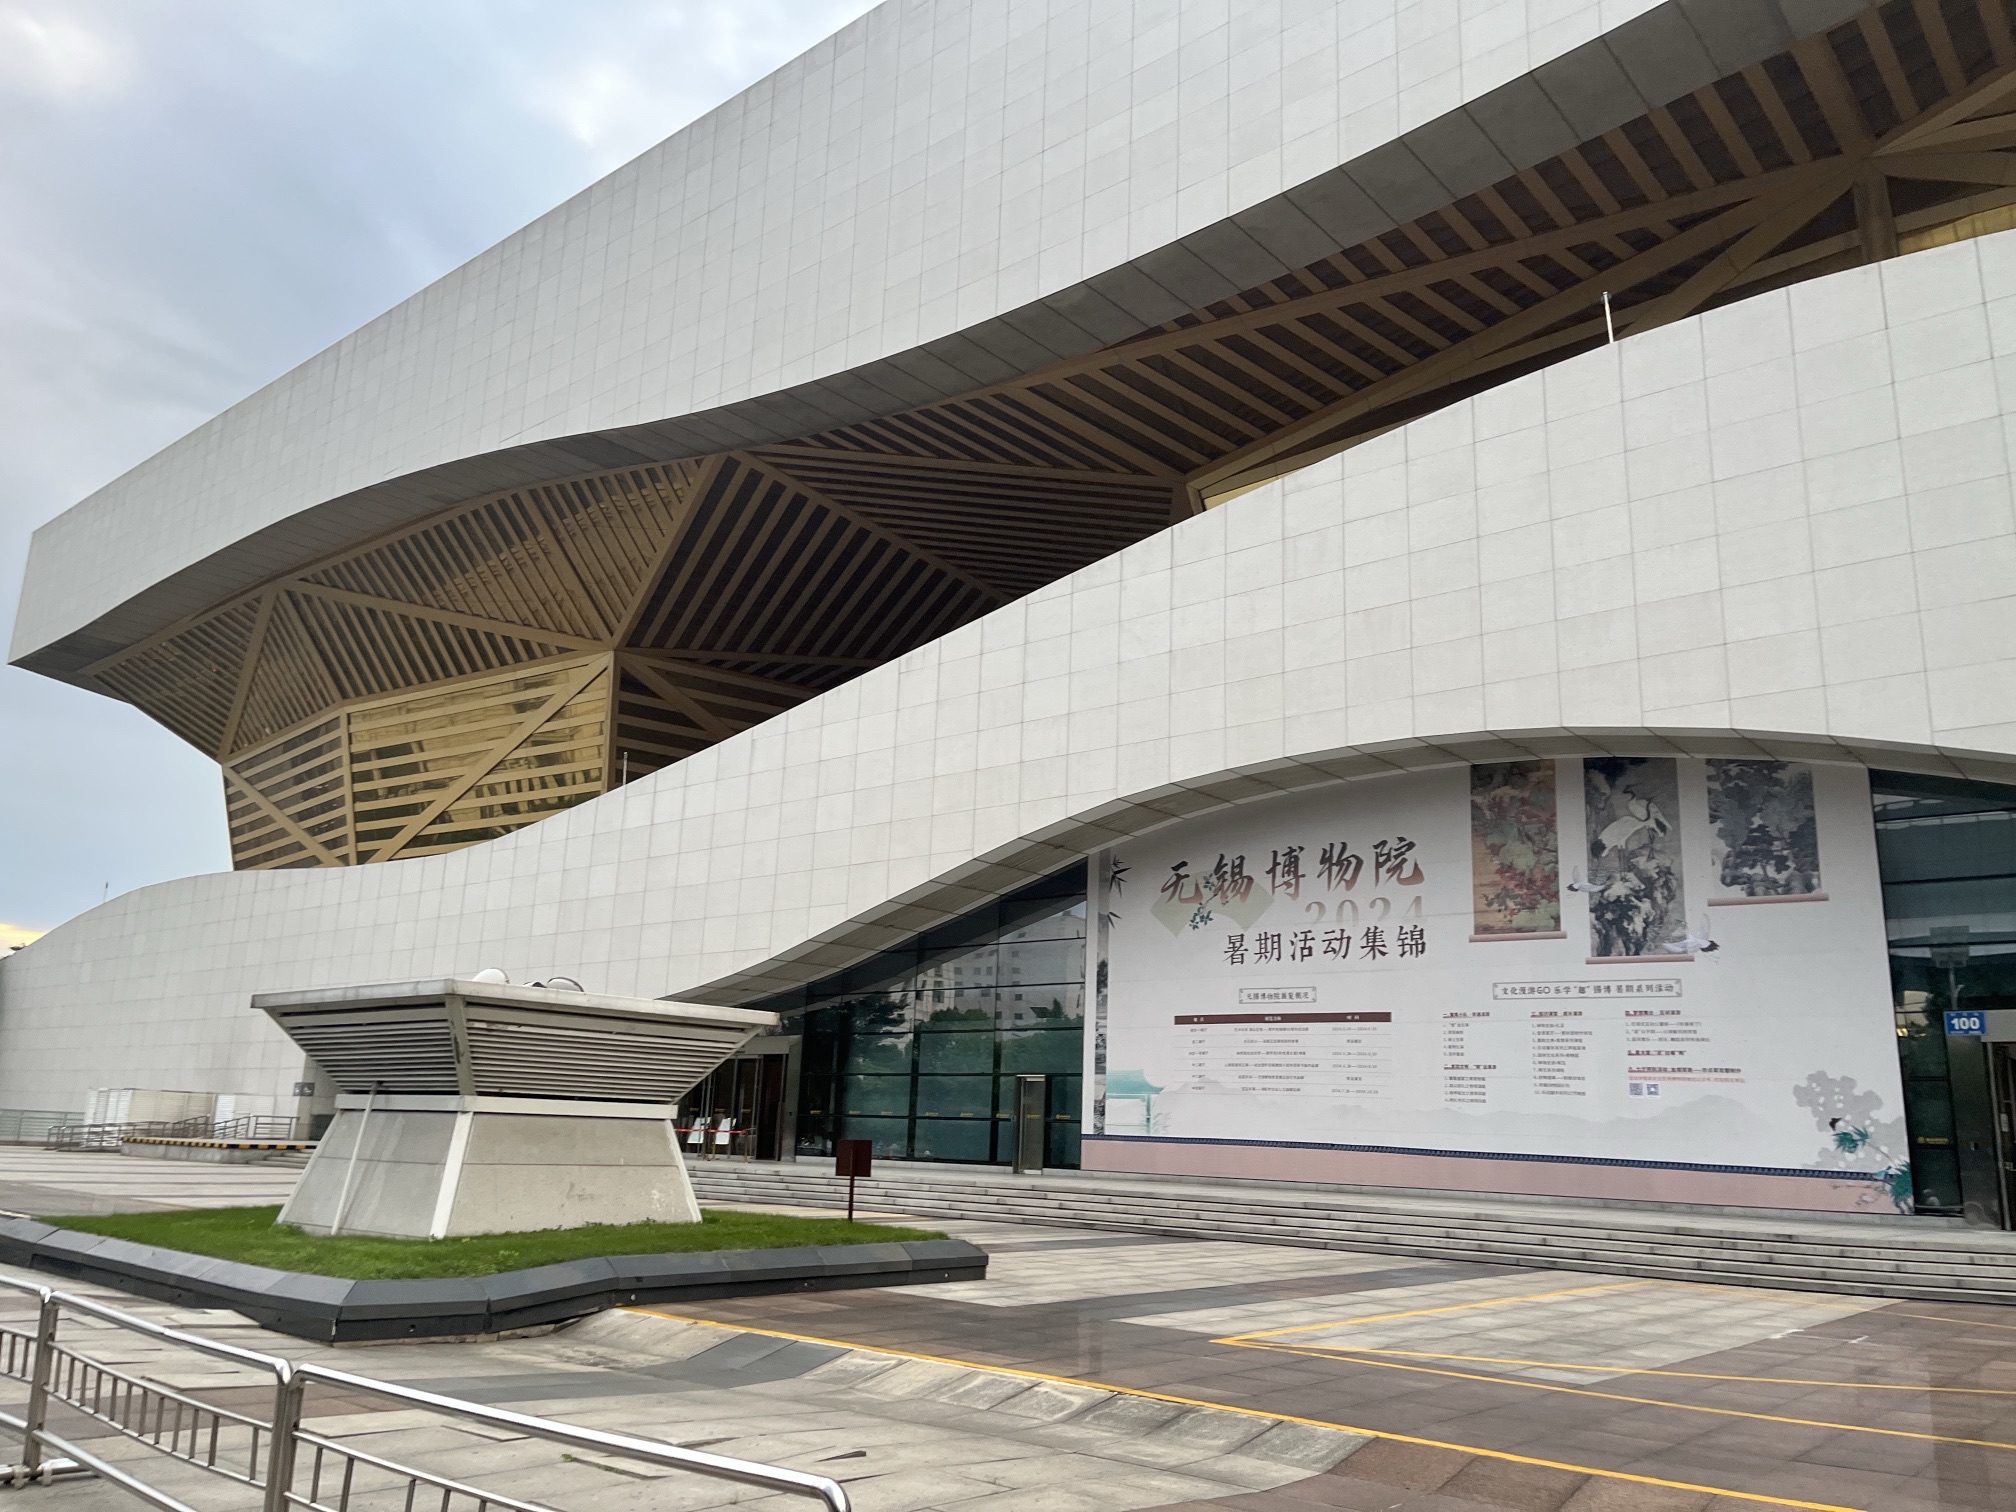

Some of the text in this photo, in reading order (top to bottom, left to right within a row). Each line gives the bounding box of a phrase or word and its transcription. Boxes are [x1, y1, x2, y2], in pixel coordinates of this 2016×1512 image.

[1161, 837, 1425, 905] 无锡博物院
[1304, 895, 1428, 930] 2024
[1223, 924, 1427, 966] 暑期活动集锦
[1951, 1017, 1980, 1030] 100
